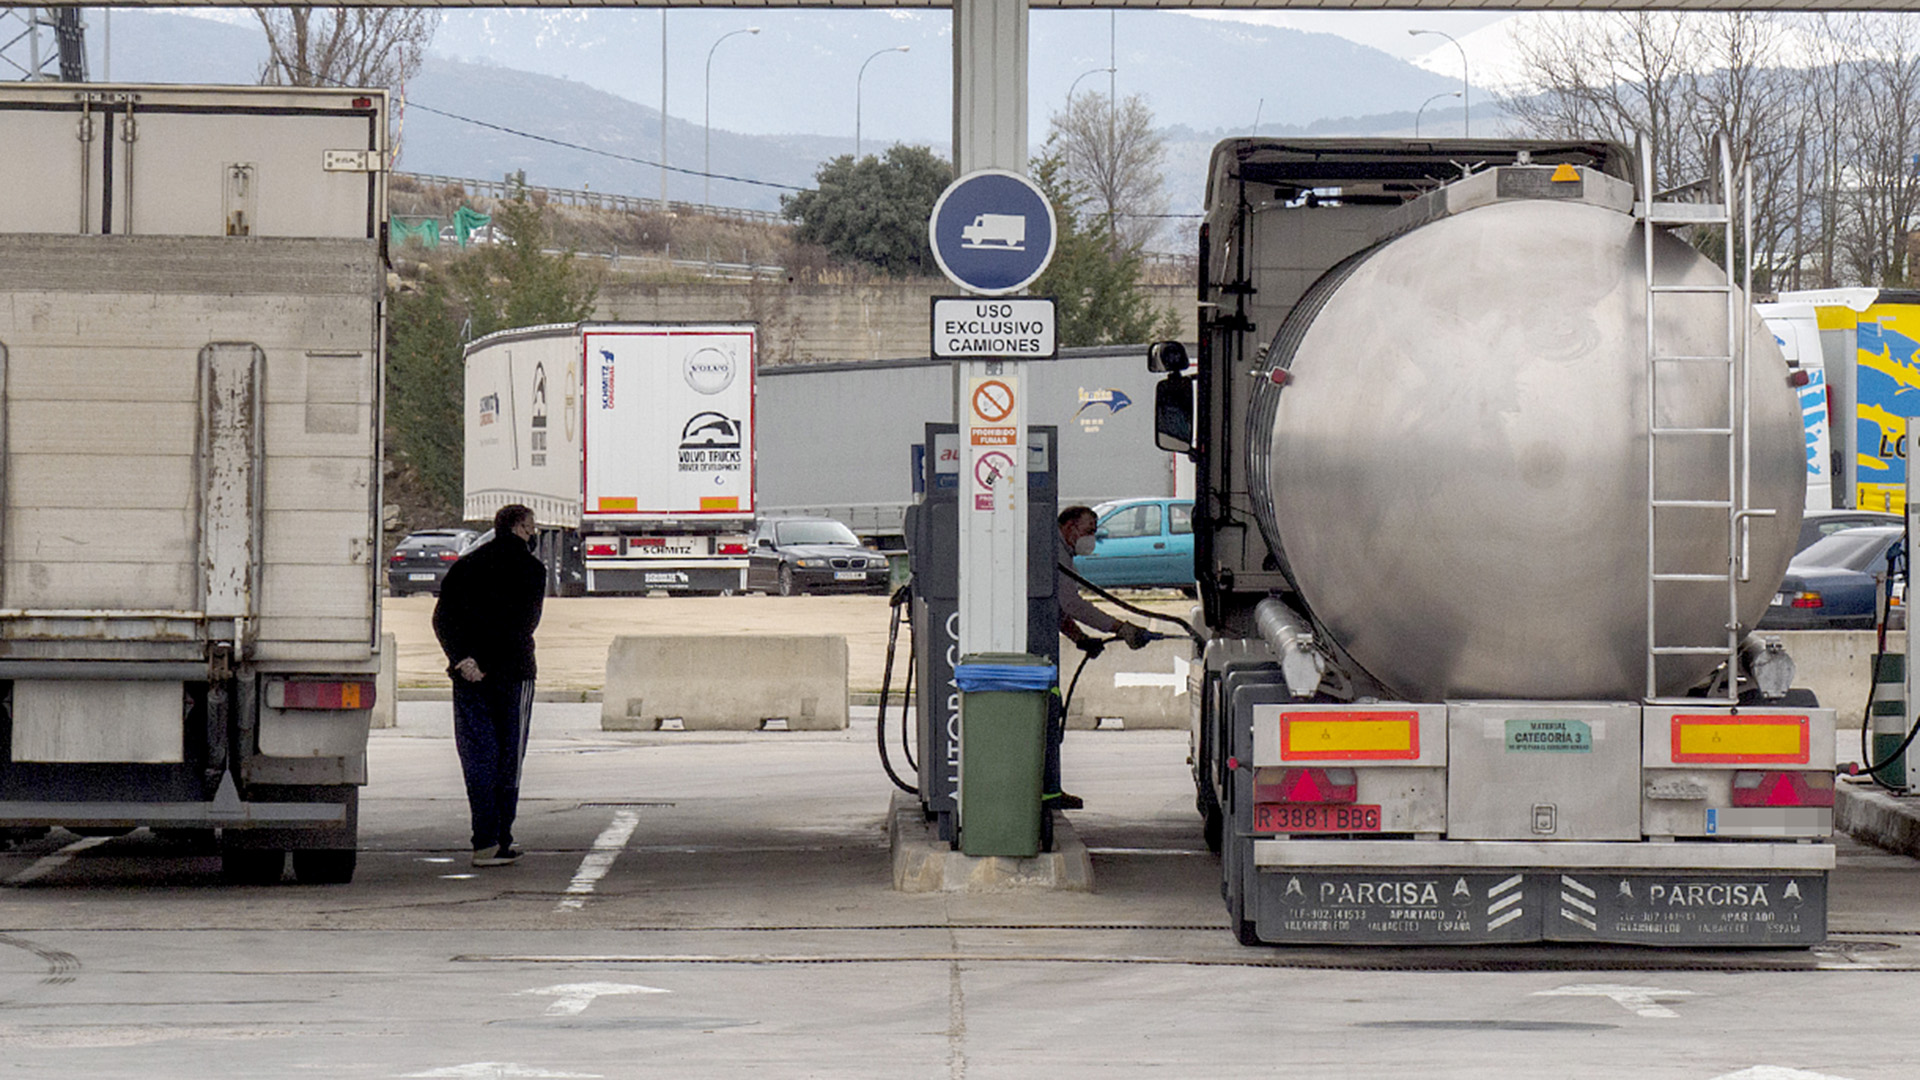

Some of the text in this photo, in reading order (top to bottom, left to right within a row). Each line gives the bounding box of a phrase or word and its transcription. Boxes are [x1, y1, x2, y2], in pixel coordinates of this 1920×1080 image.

[976, 304, 1013, 319] USO
[945, 321, 1044, 335] EXCLUSIVO
[948, 338, 1040, 352] CAMIONES
[691, 364, 729, 372] VOLVO
[972, 427, 1016, 436] PROHIBIDO
[980, 435, 1008, 444] FUMAR
[678, 451, 742, 462] VOLVO TRUCKS
[678, 463, 741, 472] DRIVER DEVELOPMENT
[643, 546, 692, 555] SCHMITZ
[1530, 723, 1567, 731] MATERIAL
[1514, 730, 1583, 743] CATEGORÍA 3
[1258, 807, 1378, 829] R 3881 BBG
[1319, 882, 1439, 905] PARCISA
[1650, 884, 1769, 906] PARCISA
[1389, 909, 1445, 921] APARTADO
[1437, 919, 1471, 932] ESPAÑA
